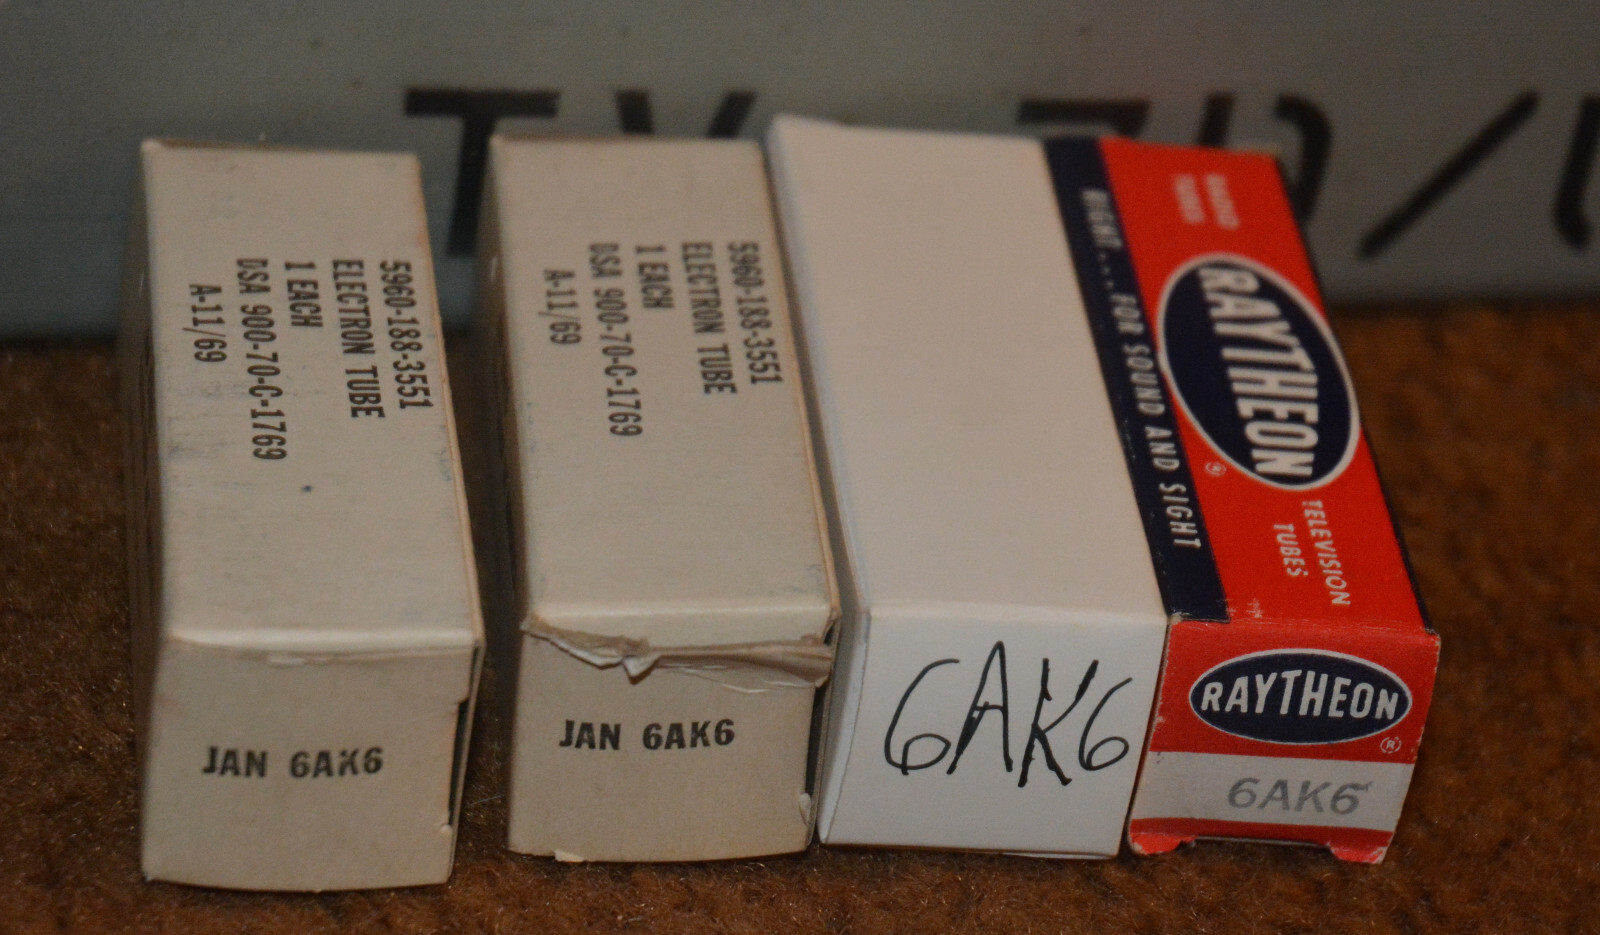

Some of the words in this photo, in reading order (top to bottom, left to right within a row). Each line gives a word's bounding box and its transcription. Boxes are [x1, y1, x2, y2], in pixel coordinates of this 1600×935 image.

[236, 258, 271, 294] DSA
[285, 261, 316, 271] 1
[637, 261, 675, 309] EACH
[682, 241, 726, 334] ELECTRON
[182, 284, 228, 362] A-11/69
[286, 279, 323, 328] EACH
[332, 259, 376, 355] ELECTRON
[538, 269, 583, 345] A-11/69
[728, 241, 784, 385] 5960-188-3551
[1109, 293, 1144, 335] FOR
[380, 259, 434, 409] 5960-188-3551
[593, 287, 643, 436] 900-70-C-1769
[240, 304, 287, 460] 900-70-C-1769
[345, 365, 386, 418] TUBE
[697, 343, 737, 394] TUBE
[1123, 344, 1166, 415] SOUND
[1197, 266, 1319, 477] RAYTHEON
[1145, 426, 1180, 471] AND
[1159, 482, 1201, 549] SIGHT
[1273, 523, 1309, 577] TUBES
[1302, 499, 1351, 605] TELEVISION
[884, 640, 1133, 788] 6AK6
[1200, 669, 1399, 721] RAYTHEON
[203, 745, 268, 778] JAN
[289, 747, 384, 779] 6AK6
[558, 719, 621, 751] JAN
[642, 718, 735, 751] 6AK6
[1227, 776, 1373, 816] 6AK6
